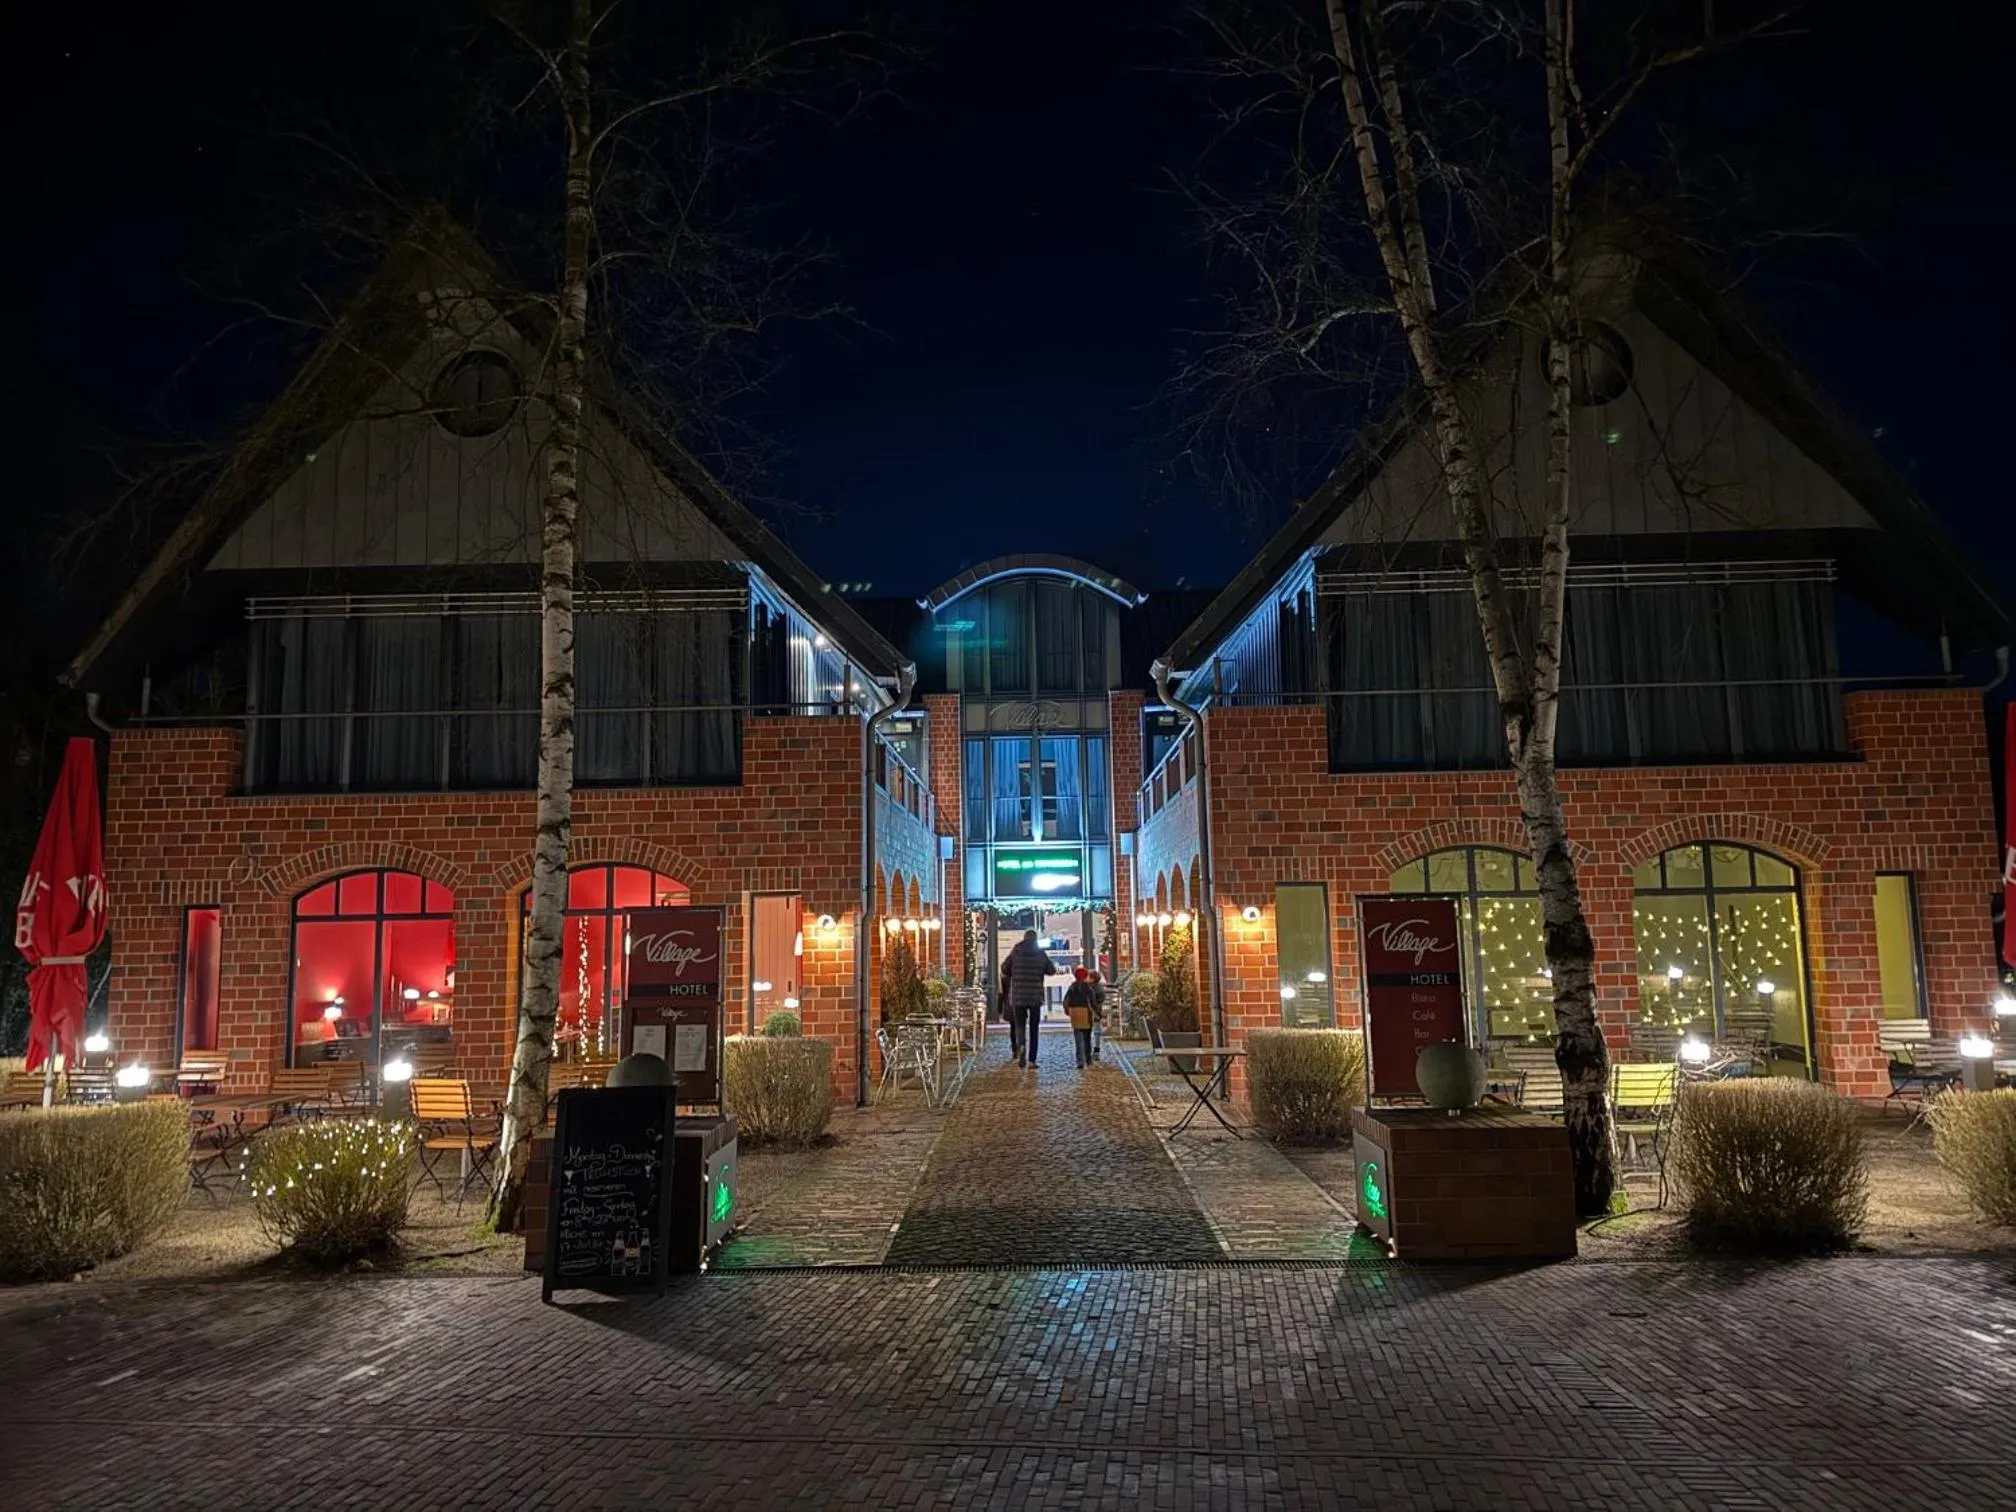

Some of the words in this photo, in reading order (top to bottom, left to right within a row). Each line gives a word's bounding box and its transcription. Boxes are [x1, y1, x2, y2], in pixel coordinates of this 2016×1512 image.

[1368, 919, 1455, 966] Village
[632, 930, 717, 977] Village
[1410, 974, 1450, 985] HOTEL
[670, 984, 708, 996] HOTEL
[1412, 992, 1436, 1002] Bistro
[1414, 1028, 1430, 1039] Bar
